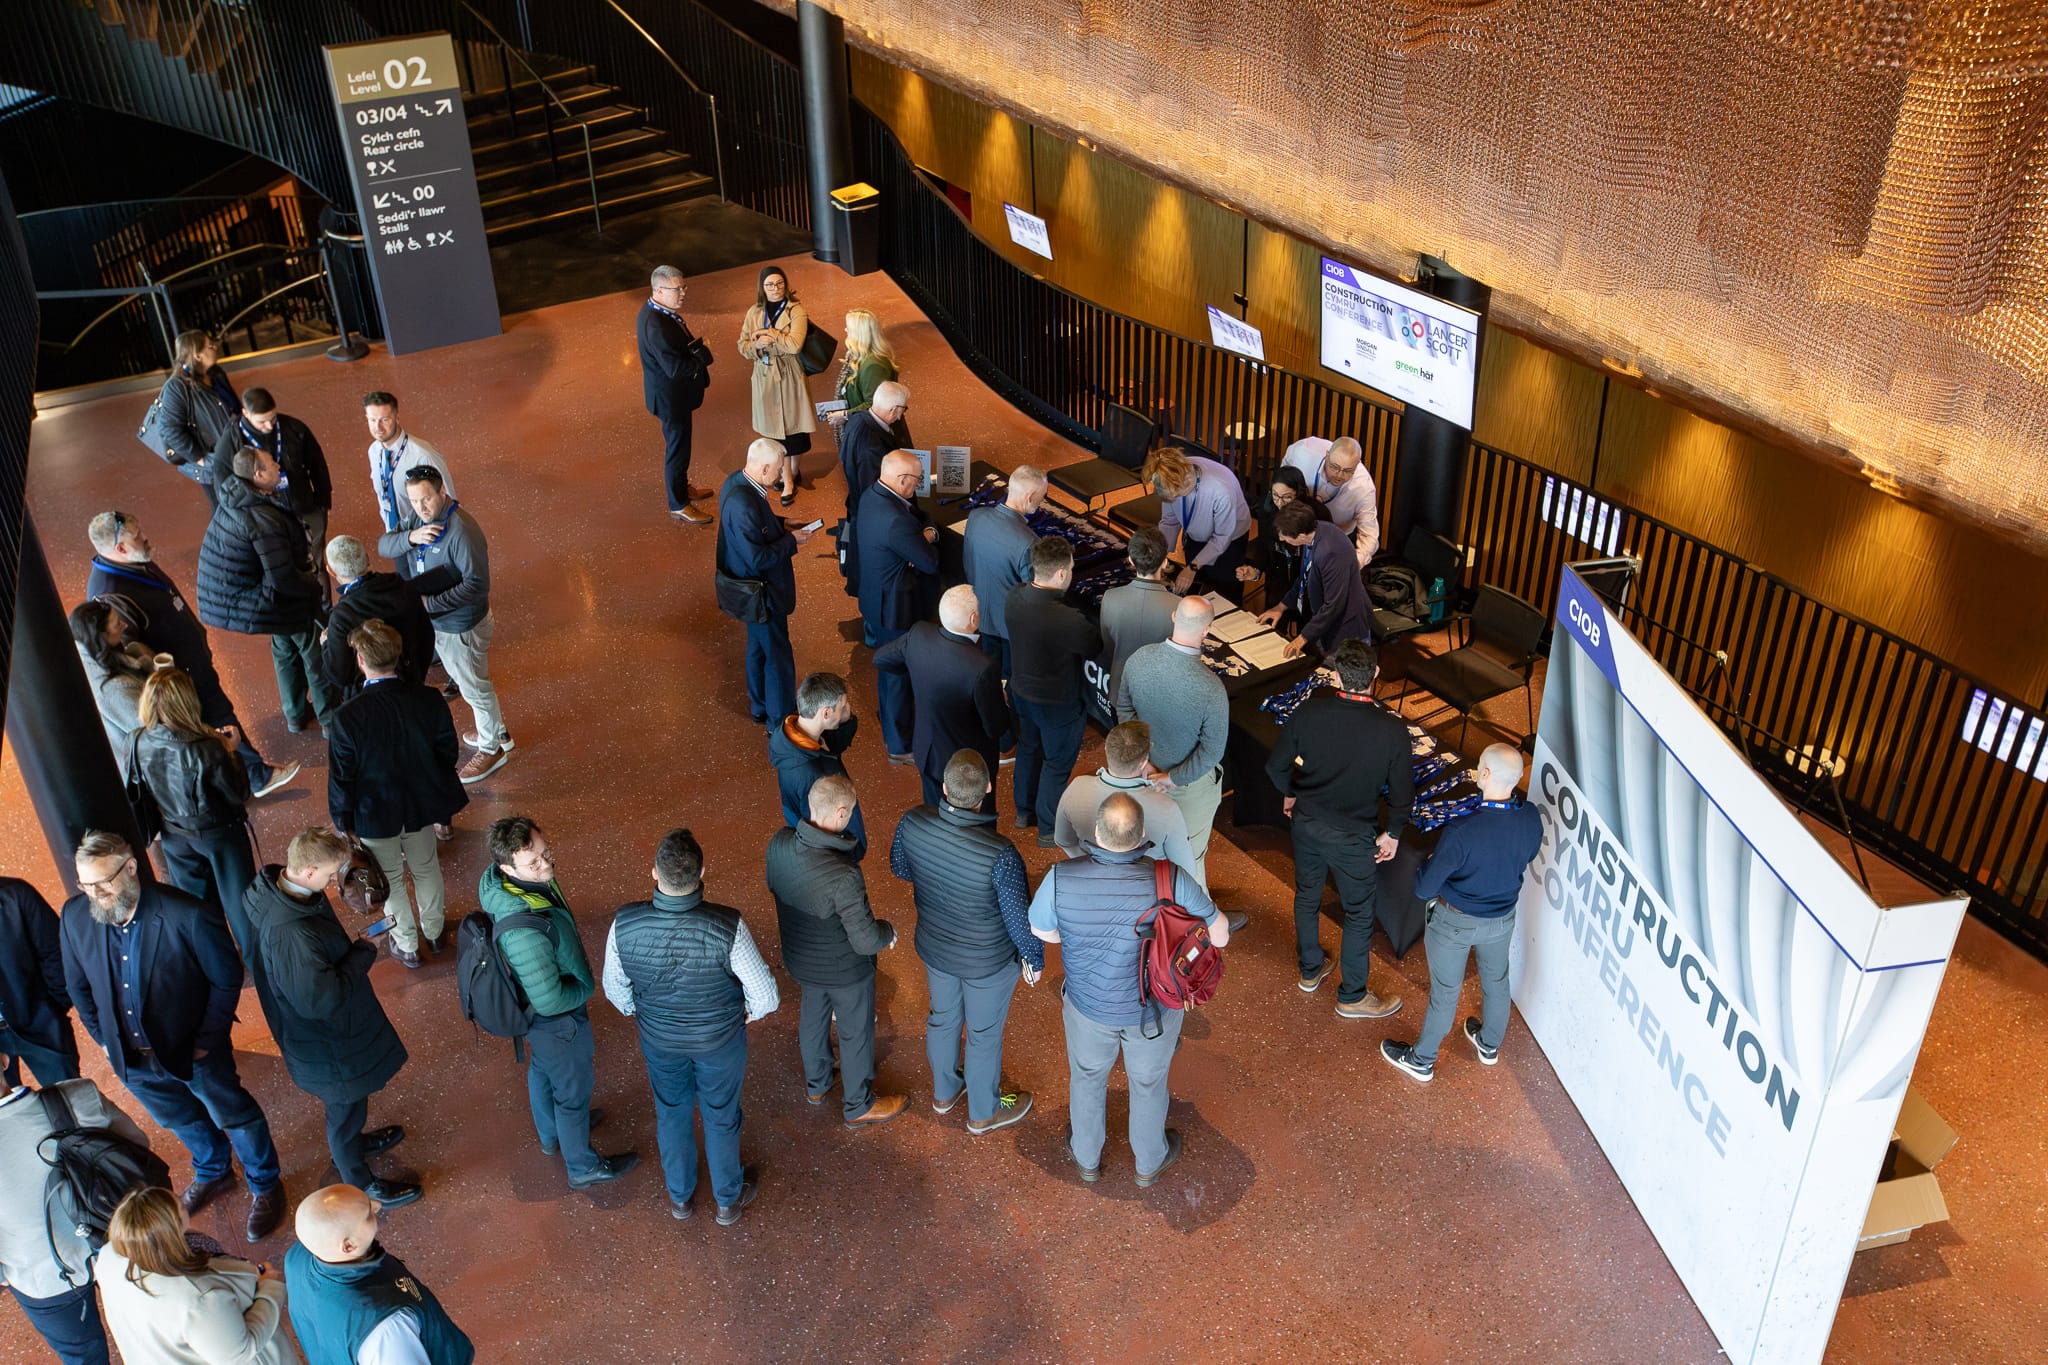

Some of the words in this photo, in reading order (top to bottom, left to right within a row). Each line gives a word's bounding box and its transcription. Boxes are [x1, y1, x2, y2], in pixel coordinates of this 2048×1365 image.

[347, 69, 377, 84] Lefel
[383, 56, 433, 90] 02
[350, 81, 382, 96] Level
[356, 104, 408, 126] 03/04
[361, 131, 394, 146] Cylch
[396, 127, 421, 140] cefn
[363, 145, 391, 157] Rear
[393, 139, 425, 152] circle
[412, 184, 435, 201] 00
[377, 209, 416, 225] Seddi'r
[418, 205, 446, 217] llawr
[379, 222, 410, 235] Stalls
[1325, 263, 1345, 278] CIOB
[1324, 282, 1393, 316] CONSTRUCTION
[1324, 291, 1356, 311] CYMRU
[1324, 301, 1383, 331] CONFERENCE
[1427, 322, 1468, 350] LANCER
[1426, 337, 1462, 361] SCOTT
[1395, 360, 1419, 375] green
[1569, 598, 1601, 648] CIOB
[1541, 762, 1800, 1132] CONSTRUCTION
